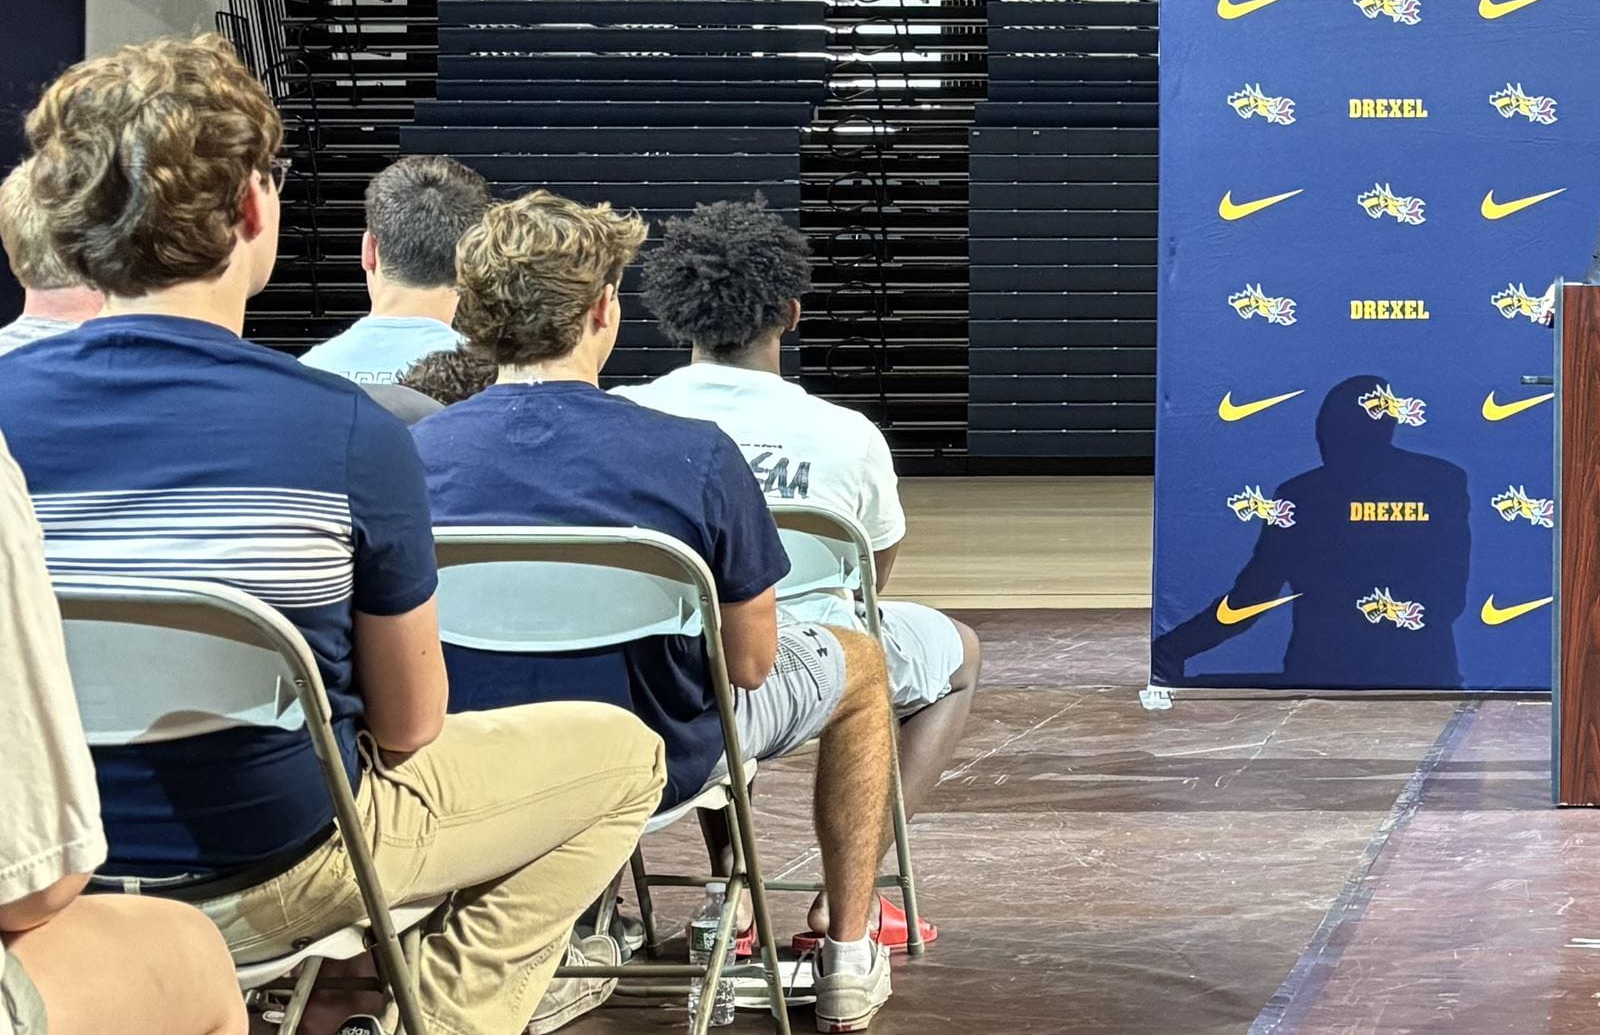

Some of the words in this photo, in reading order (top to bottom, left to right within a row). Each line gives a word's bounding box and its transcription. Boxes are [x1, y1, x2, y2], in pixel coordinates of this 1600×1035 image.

[1349, 98, 1429, 118] DREXEL
[1350, 300, 1430, 320] DREXEL
[1350, 501, 1430, 521] DREXEL
